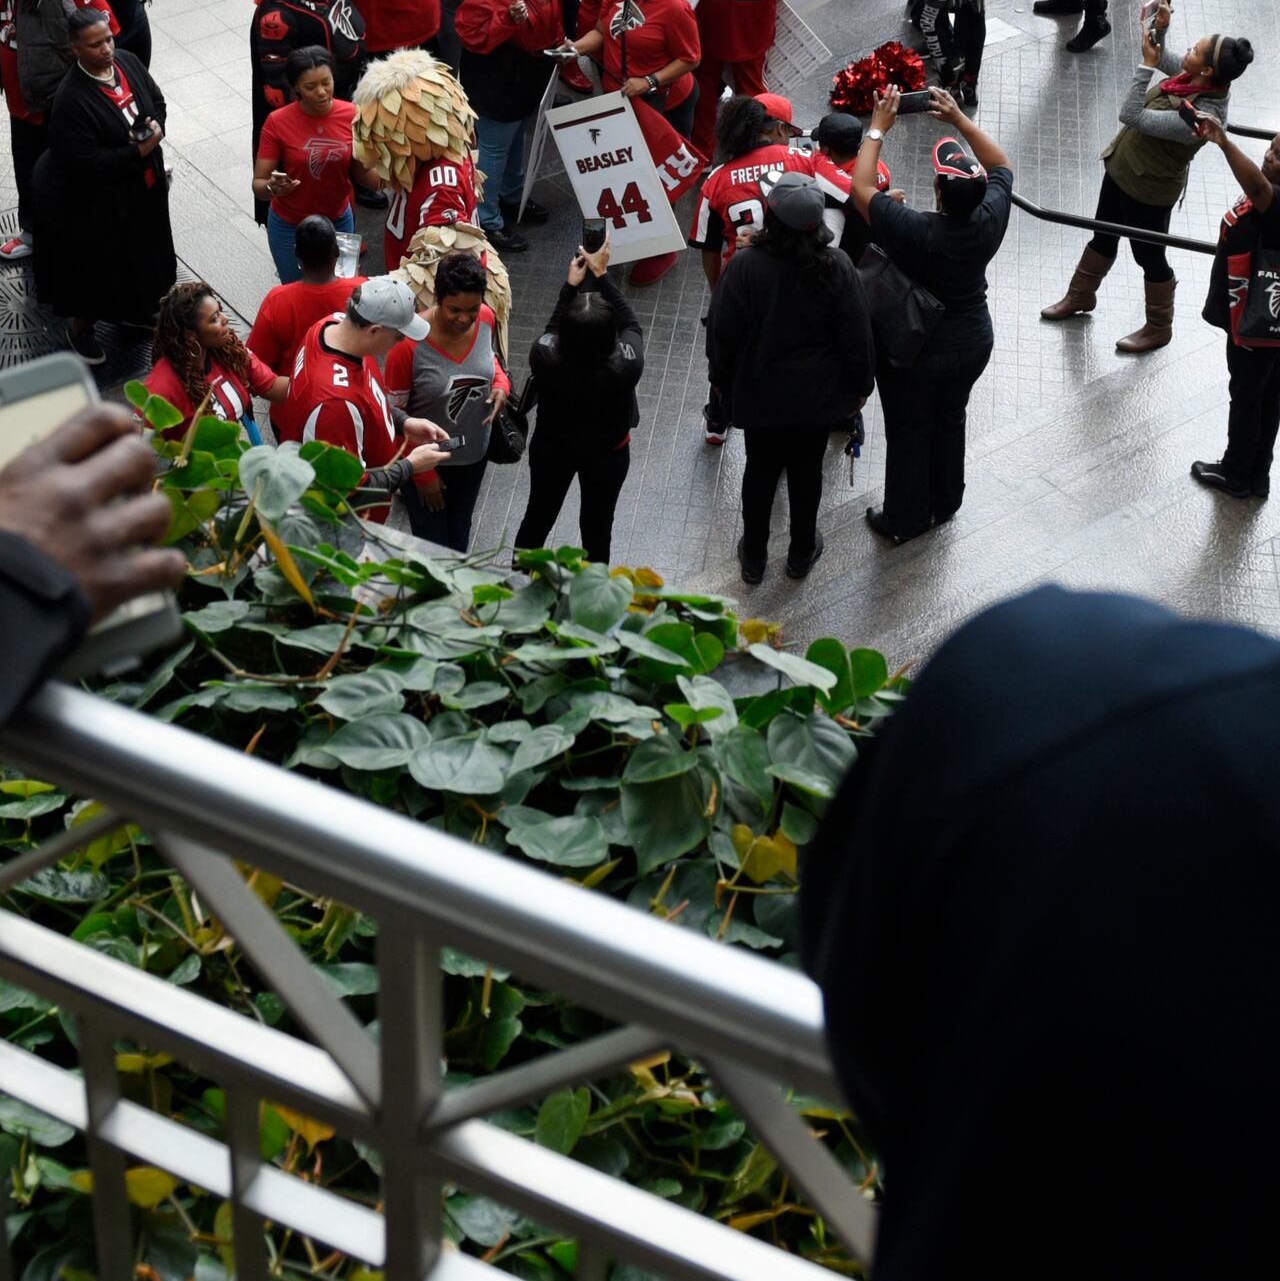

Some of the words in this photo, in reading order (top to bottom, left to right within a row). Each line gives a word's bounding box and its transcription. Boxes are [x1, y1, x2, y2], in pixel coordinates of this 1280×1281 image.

[576, 146, 634, 174] BEASLEY
[429, 165, 458, 188] 00
[730, 162, 785, 186] FREEMAN
[596, 181, 653, 230] 44
[332, 363, 349, 388] 2
